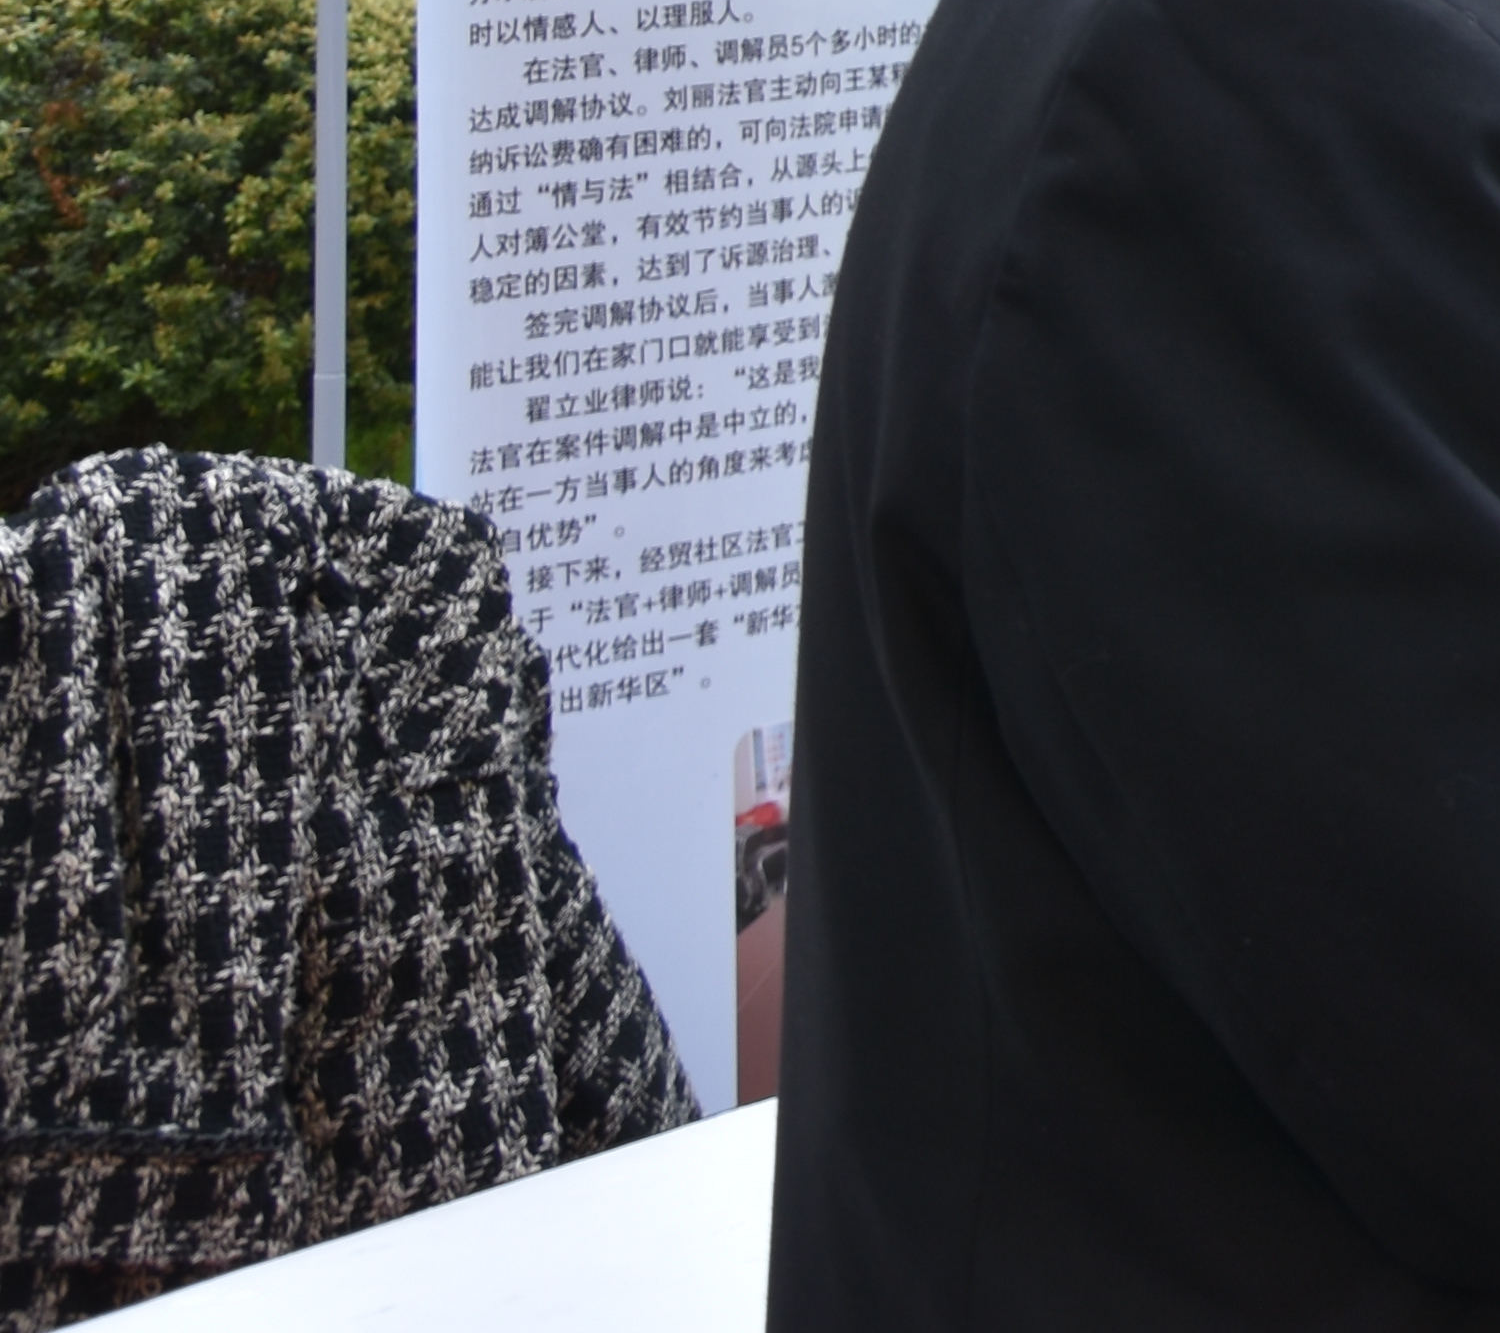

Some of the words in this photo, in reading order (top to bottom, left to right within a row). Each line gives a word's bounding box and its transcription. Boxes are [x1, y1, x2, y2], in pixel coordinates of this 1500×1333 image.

[523, 20, 929, 86] 在法官、律师、调解员5个多小时的
[469, 105, 889, 177] 纳诉讼费确有困难的，可向法院申请
[469, 148, 872, 220] 通过“情与法”相结合，从源头上
[469, 313, 829, 391] 能让我们在家门口就能享受到
[469, 400, 808, 475] 法官在案件调解中是中立的，
[519, 559, 802, 635] 于“法官+律师+调解员
[545, 601, 799, 675] 代化给出一套“新华
